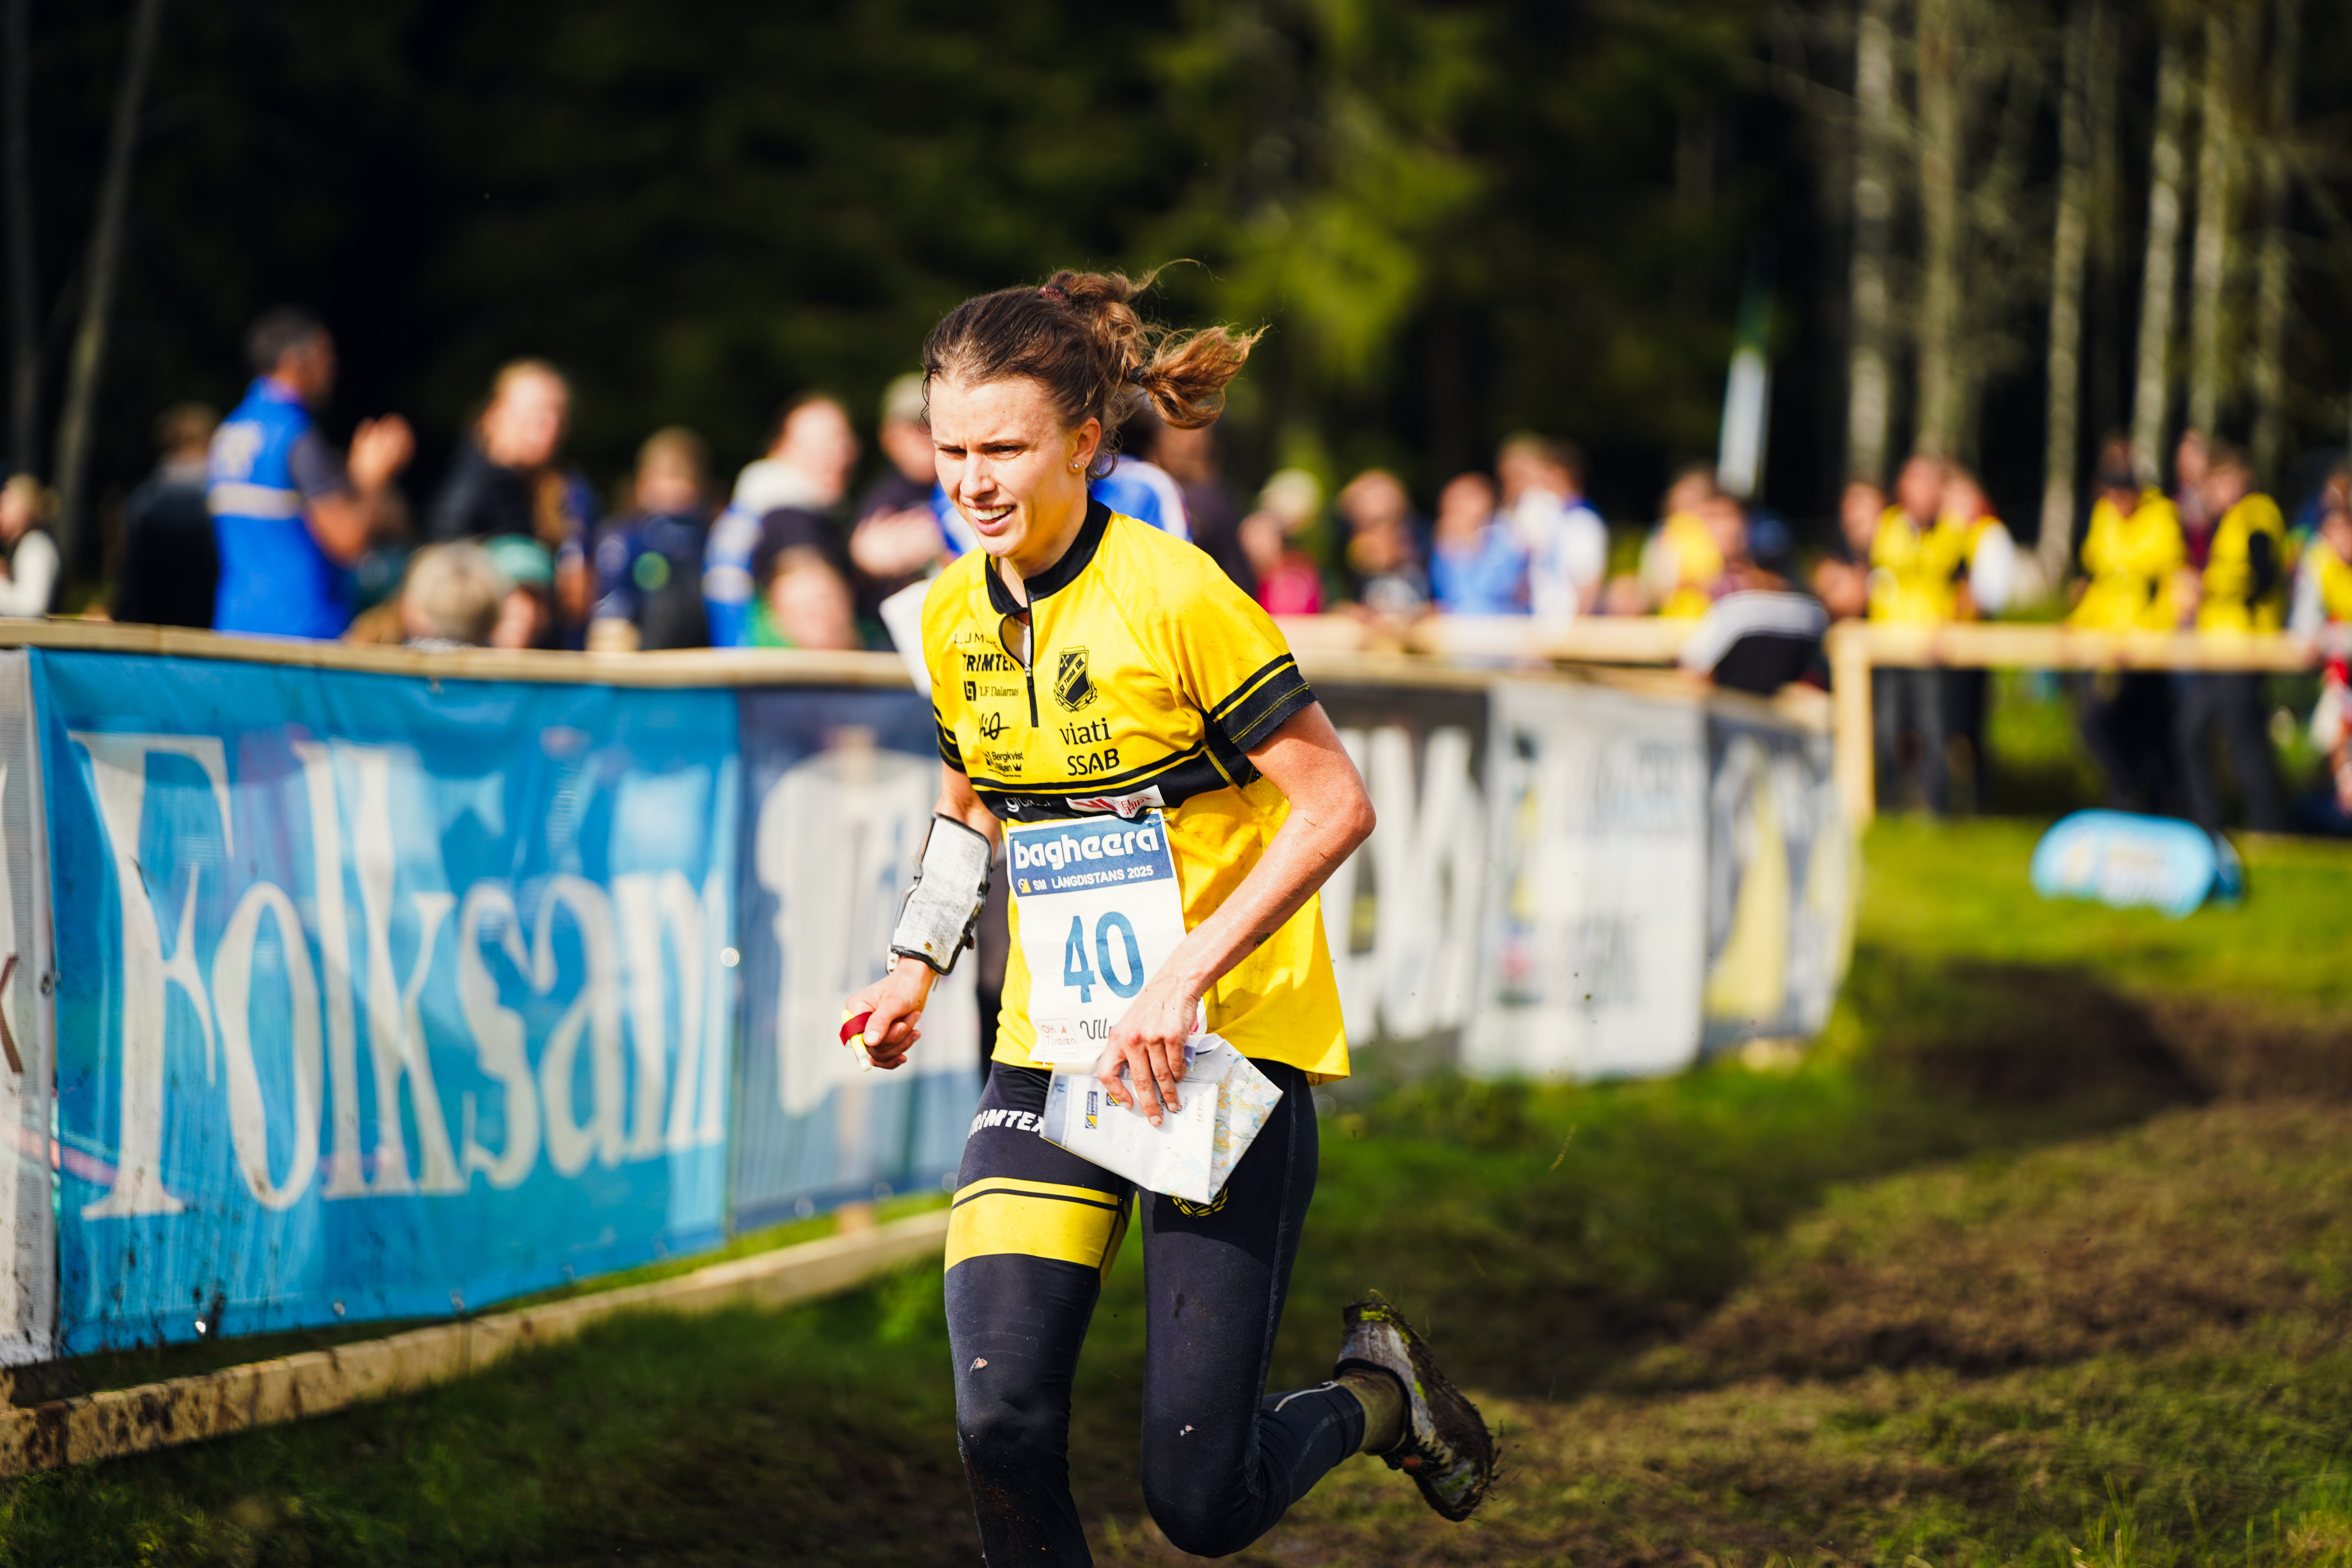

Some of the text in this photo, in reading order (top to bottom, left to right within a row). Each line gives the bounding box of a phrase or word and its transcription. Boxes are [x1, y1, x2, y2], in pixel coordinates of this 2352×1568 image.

[980, 686, 1019, 697] LF Dalarnas
[1059, 717, 1112, 745] viati
[992, 751, 1024, 763] Bergkvist
[1067, 748, 1120, 776] SSAB
[1013, 828, 1160, 870] bagheera
[1032, 865, 1154, 891] SM LÅNGDISTANS 2025
[1063, 911, 1144, 1004] 40
[67, 729, 726, 1220] Folksam
[1045, 1035, 1076, 1045] Tisaren
